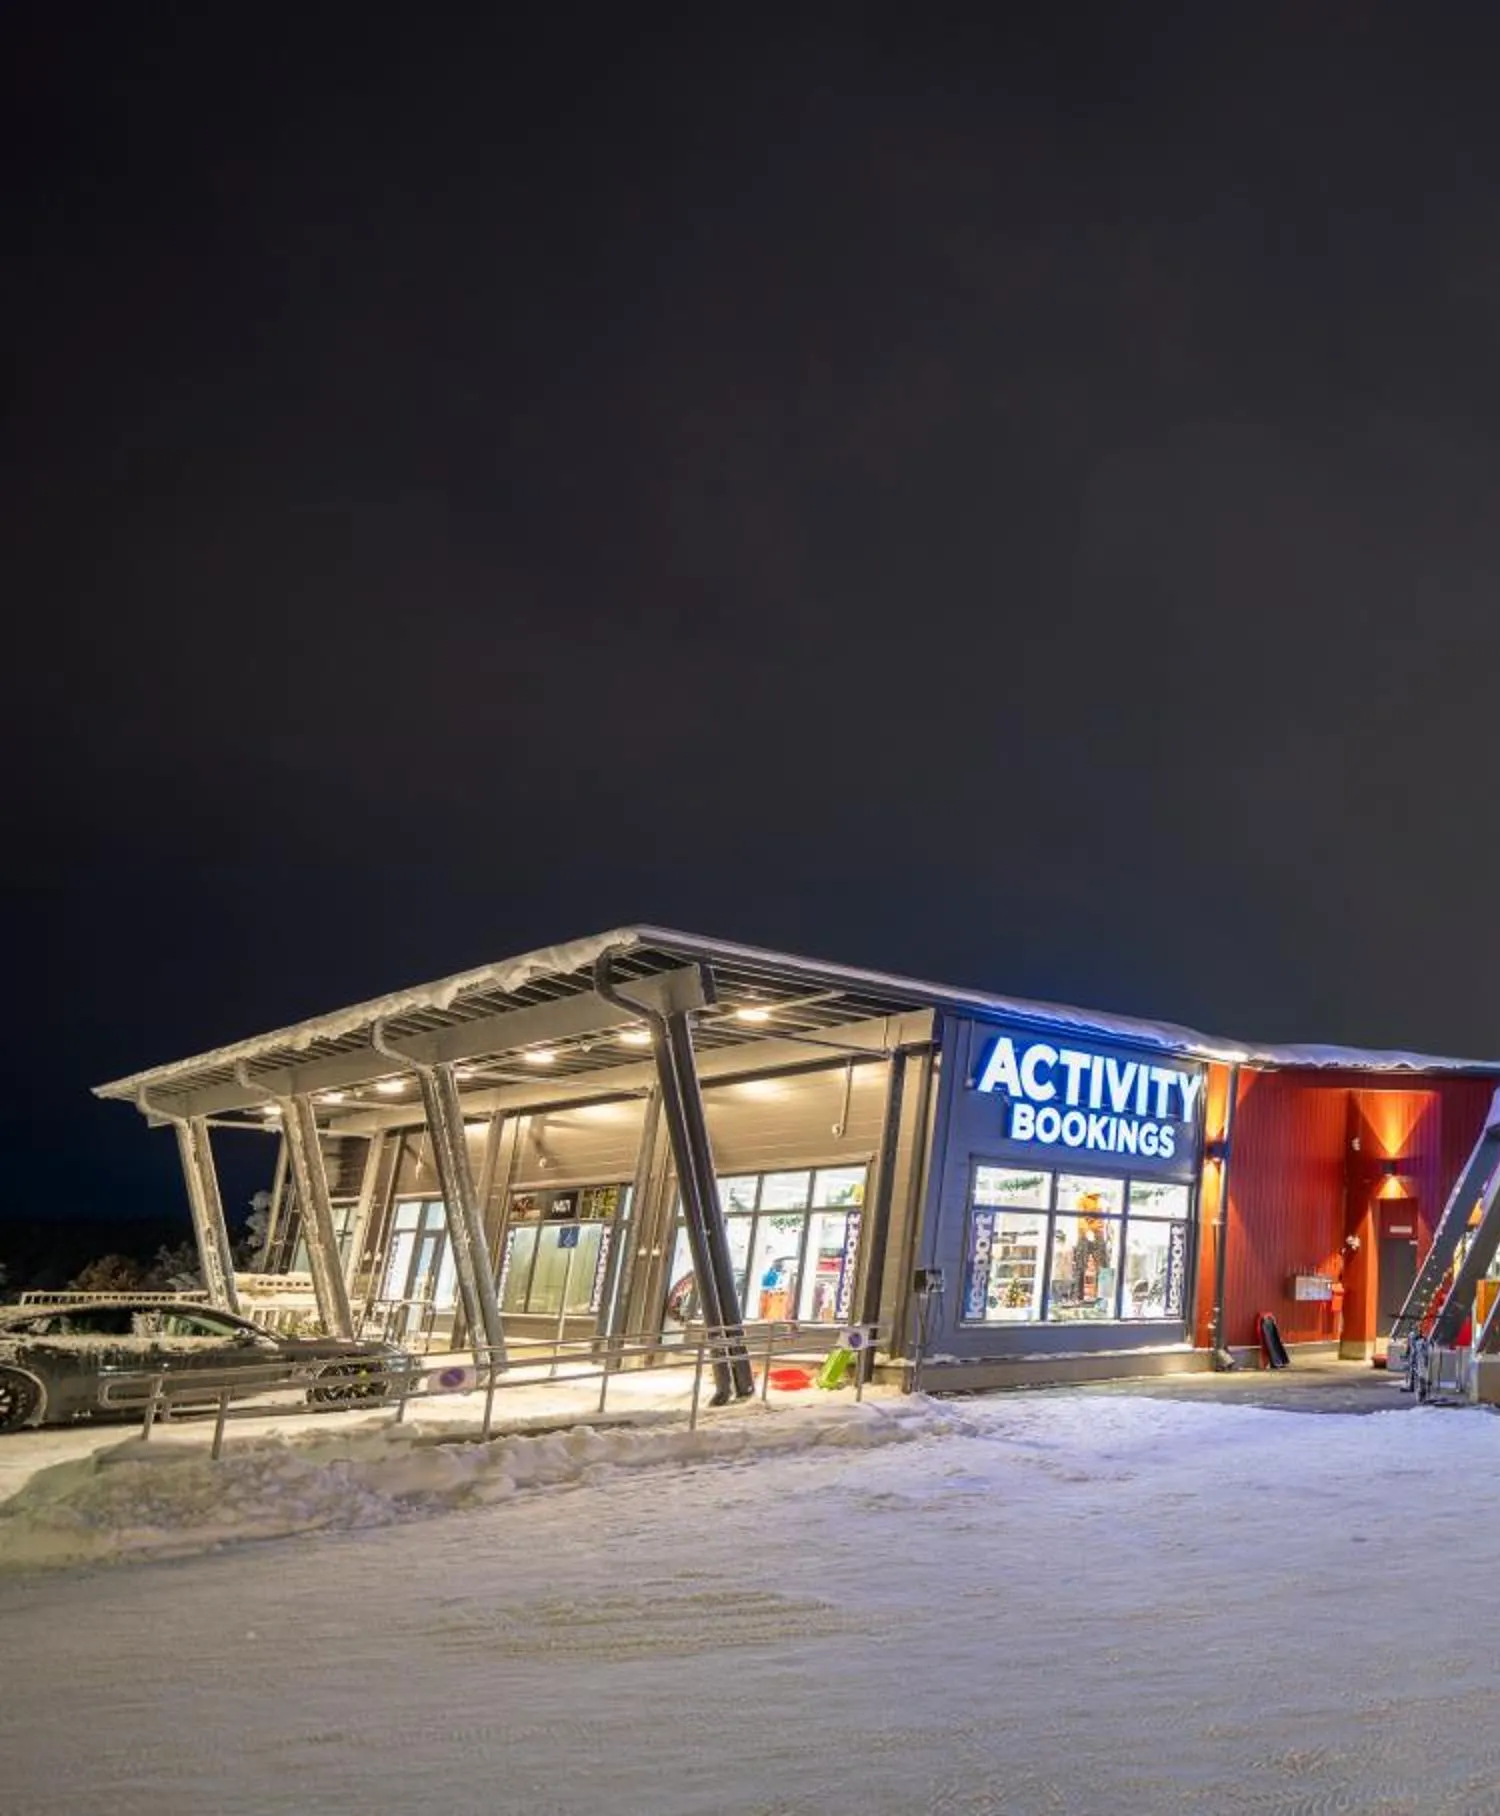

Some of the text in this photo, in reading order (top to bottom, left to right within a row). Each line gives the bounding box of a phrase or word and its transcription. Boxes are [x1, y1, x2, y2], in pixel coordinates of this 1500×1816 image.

[978, 1037, 1201, 1122] ACTIVITY
[1011, 1104, 1174, 1158] BOOKINGS
[965, 1213, 992, 1318] kesport
[1165, 1225, 1184, 1315] kesport
